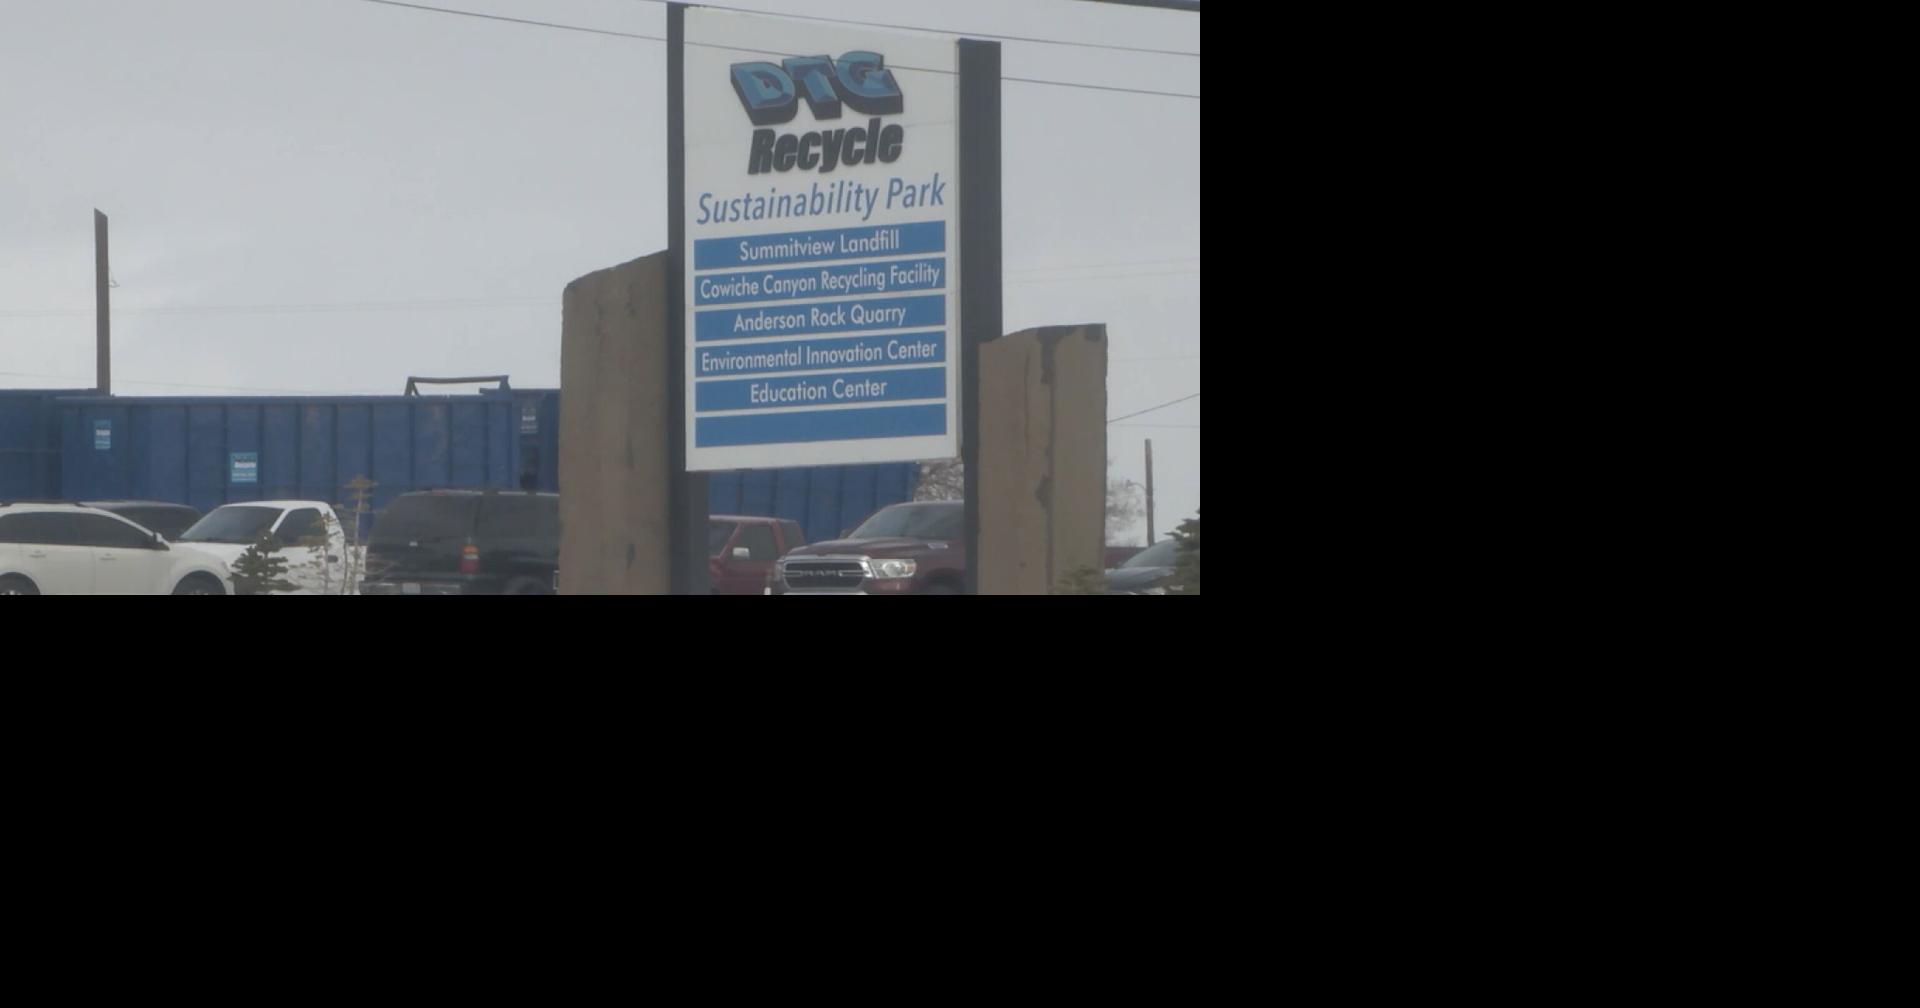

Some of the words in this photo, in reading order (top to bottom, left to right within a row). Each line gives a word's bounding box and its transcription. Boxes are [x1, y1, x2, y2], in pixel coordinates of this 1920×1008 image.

[731, 51, 903, 125] DTG
[748, 118, 904, 174] Recycle
[697, 181, 879, 225] Sustainability
[886, 173, 946, 210] Park
[739, 235, 835, 261] Summitview
[841, 229, 899, 253] Landfill
[701, 276, 759, 299] Cowiche
[763, 271, 816, 297] Canyon
[821, 266, 886, 293] Recycling
[890, 263, 940, 288] Facility
[734, 310, 805, 333] Anderson
[811, 306, 846, 326] Rock
[851, 304, 906, 328] Quarry
[702, 345, 802, 371] Environmental
[807, 341, 883, 364] Innovation
[887, 340, 937, 359] Center
[750, 381, 827, 404] Education
[832, 379, 887, 398] Center
